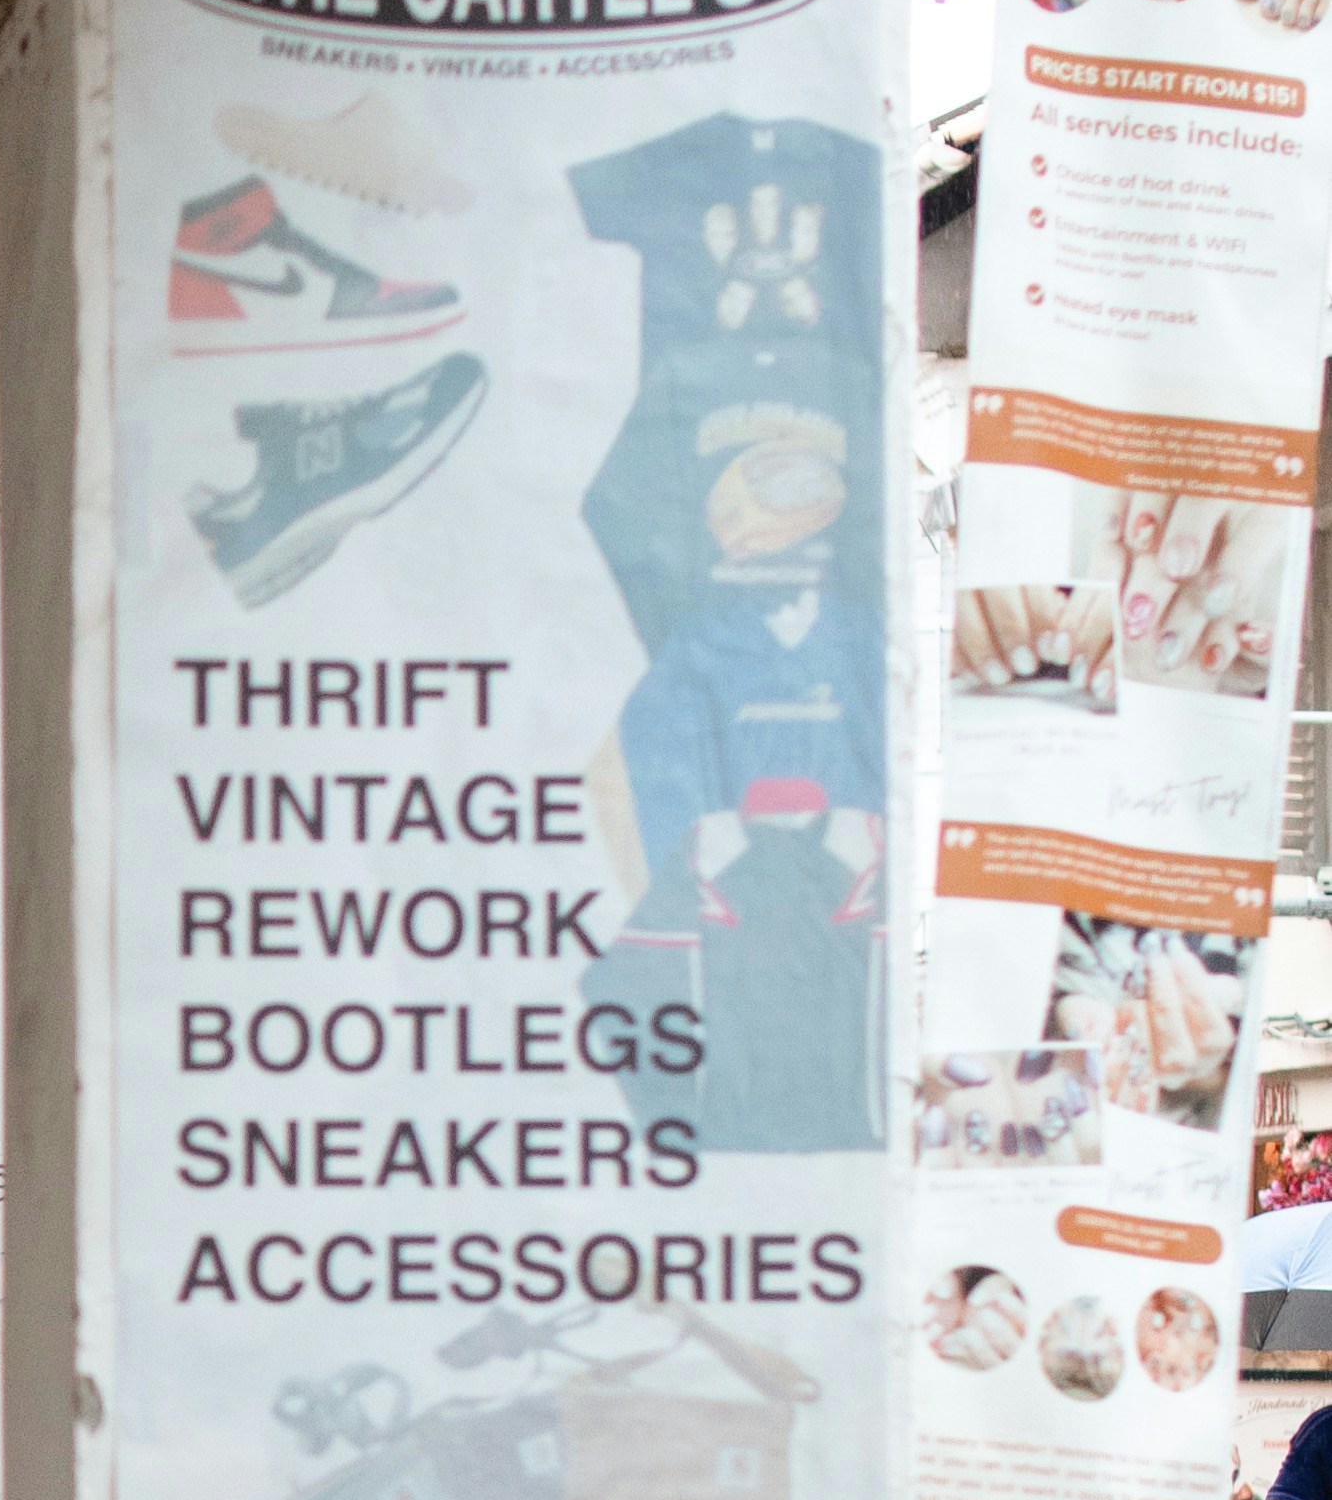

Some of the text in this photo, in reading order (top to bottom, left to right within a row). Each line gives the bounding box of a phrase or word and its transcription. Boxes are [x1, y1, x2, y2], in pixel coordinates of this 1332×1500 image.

[260, 36, 735, 79] SNEAKERS VINTAGE ACCESSORIES
[1029, 55, 1298, 109] PRICES START FROM $15!
[1030, 103, 1303, 158] All services include:
[1117, 173, 1137, 190] of
[1141, 175, 1174, 193] hot
[1179, 178, 1231, 199] drink
[1054, 215, 1180, 248] Entertainment
[1108, 306, 1142, 323] eye
[1145, 308, 1198, 327] mask
[174, 658, 510, 729] THRIFT
[175, 773, 586, 845] VINTAGE
[178, 889, 604, 960] REWORK
[179, 1003, 707, 1076] BOOTLEGS
[178, 1117, 700, 1189] SNEAKERS
[178, 1234, 864, 1304] ACCESSORIES
